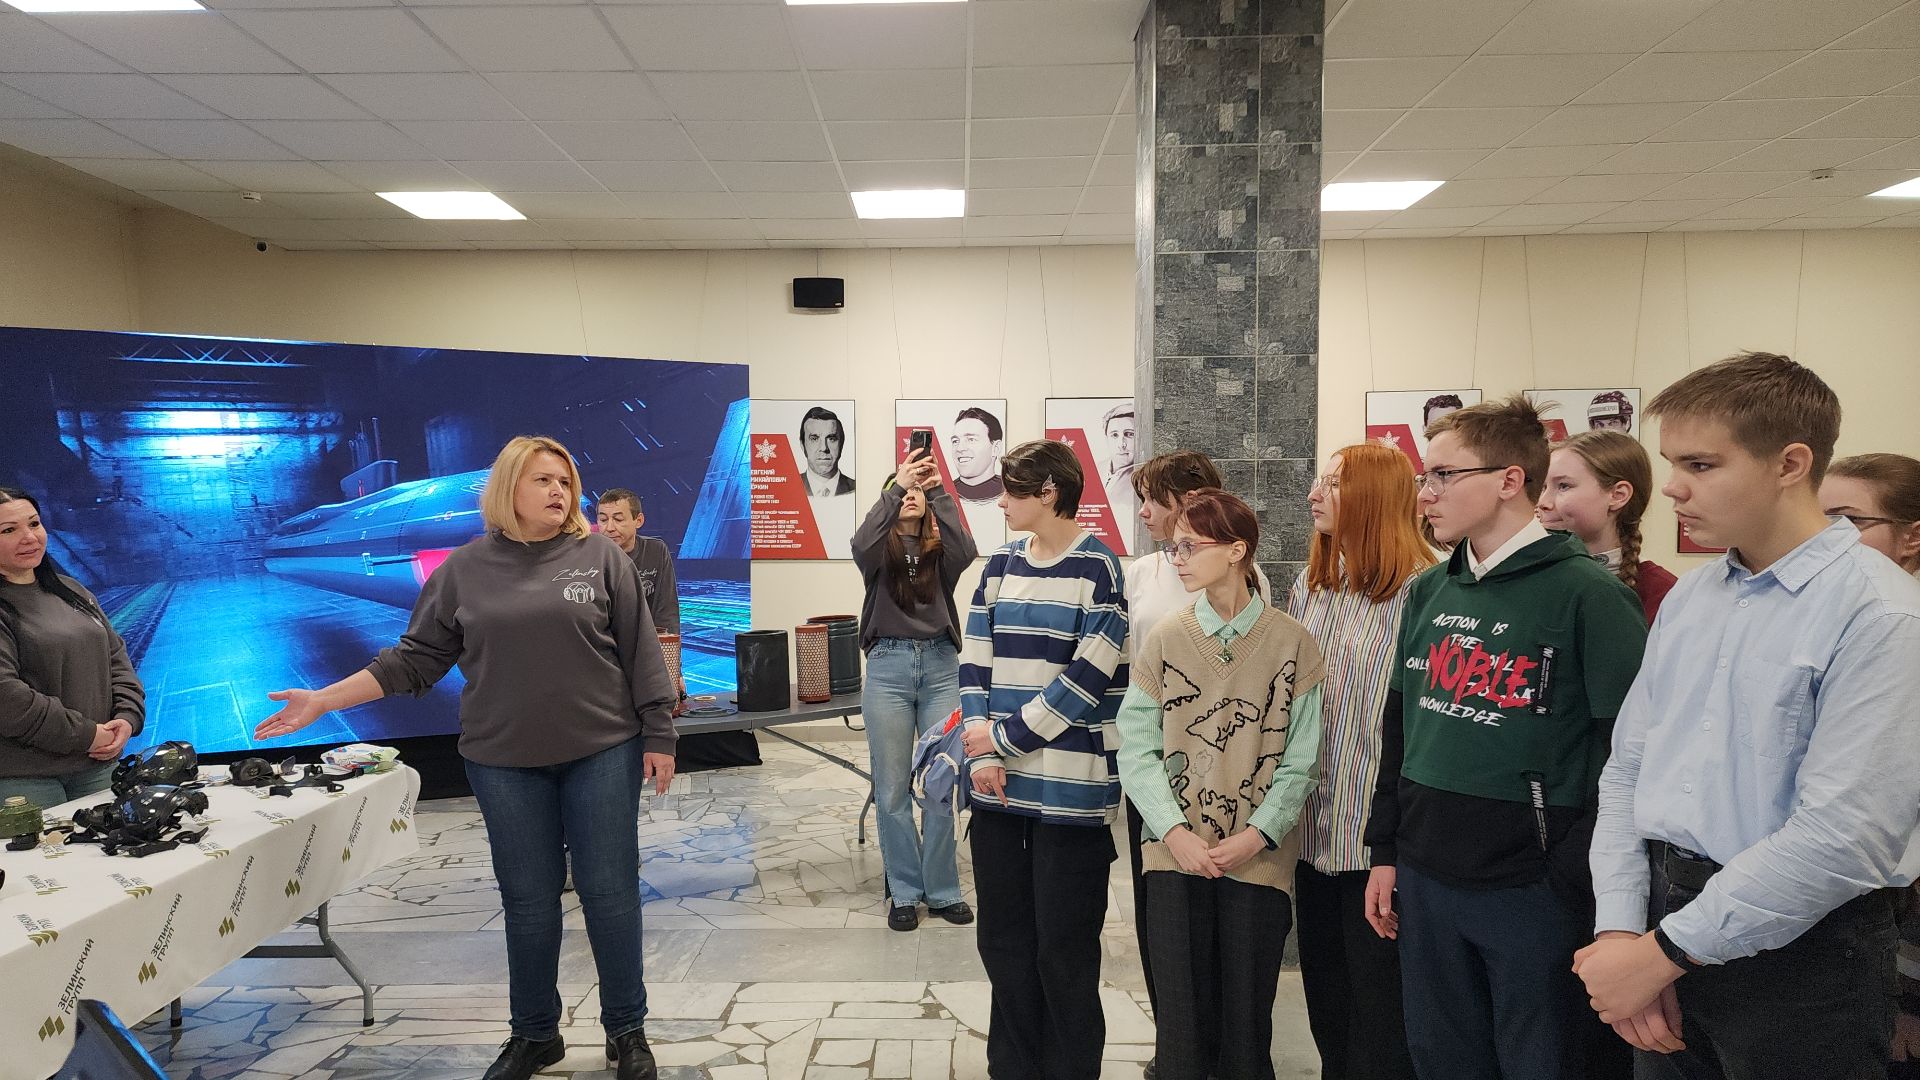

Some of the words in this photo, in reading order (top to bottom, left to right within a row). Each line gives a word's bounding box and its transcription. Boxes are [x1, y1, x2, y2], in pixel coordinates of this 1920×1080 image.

[1432, 612, 1482, 631] ACTION
[1491, 621, 1509, 636] IS
[1450, 633, 1484, 650] THE
[1424, 634, 1539, 709] NOBLE
[295, 823, 317, 877] ЗЕЛИНСКИЙ
[299, 851, 312, 880] ГРУПП
[229, 855, 255, 913] ЗЕЛИНСКИЙ
[233, 886, 248, 917] ГРУПП
[151, 892, 183, 957] ЗЕЛИНСКИЙ
[156, 927, 175, 962] ГРУПП
[57, 938, 95, 1011] ЗЕЛИНСКИЙ
[64, 976, 87, 1016] ГРУПП
